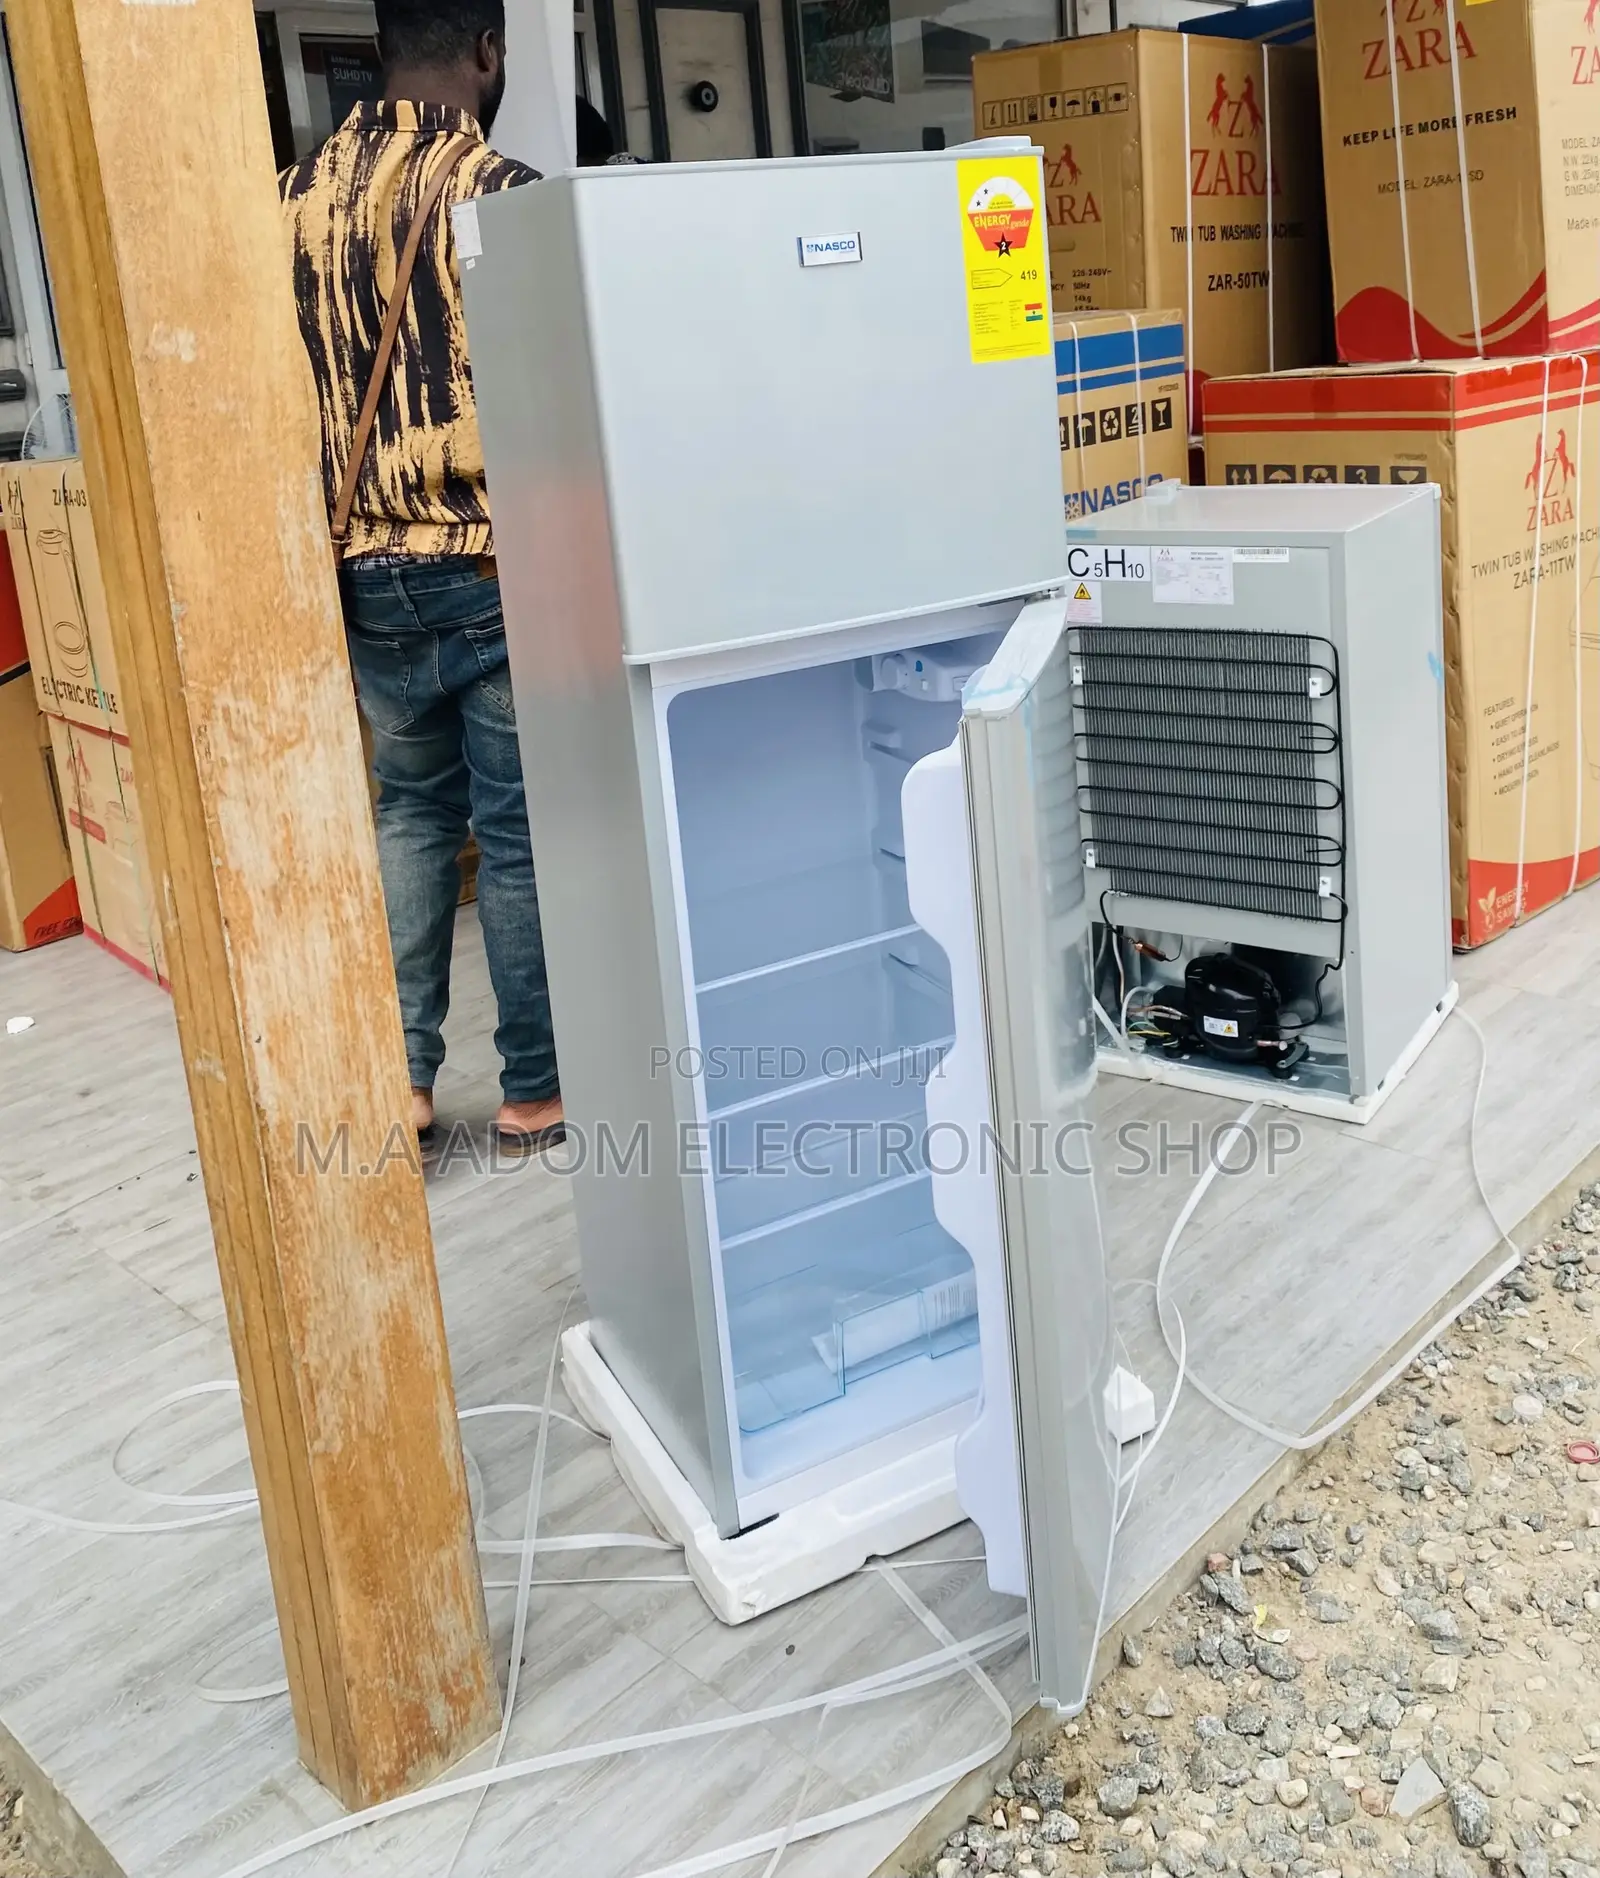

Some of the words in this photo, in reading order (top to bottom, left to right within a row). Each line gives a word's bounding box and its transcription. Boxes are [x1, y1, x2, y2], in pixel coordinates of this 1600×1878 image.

[1362, 20, 1478, 80] ZARA
[1343, 131, 1379, 147] KEEP
[1383, 123, 1414, 140] LIFE
[1418, 116, 1460, 134] MORE
[1465, 106, 1517, 127] FRESH
[1190, 149, 1282, 196] ZARA
[1423, 169, 1485, 189] ZARA-1SD
[974, 213, 1012, 229] ENERGY
[1198, 225, 1217, 242] TUB
[1221, 223, 1262, 241] WASHING
[814, 240, 856, 252] NASCO
[1000, 241, 1007, 250] 2
[1020, 269, 1038, 280] 419
[1207, 270, 1270, 292] ZAR-50TW
[1471, 560, 1501, 579] TWIN
[1502, 551, 1521, 571] TUB
